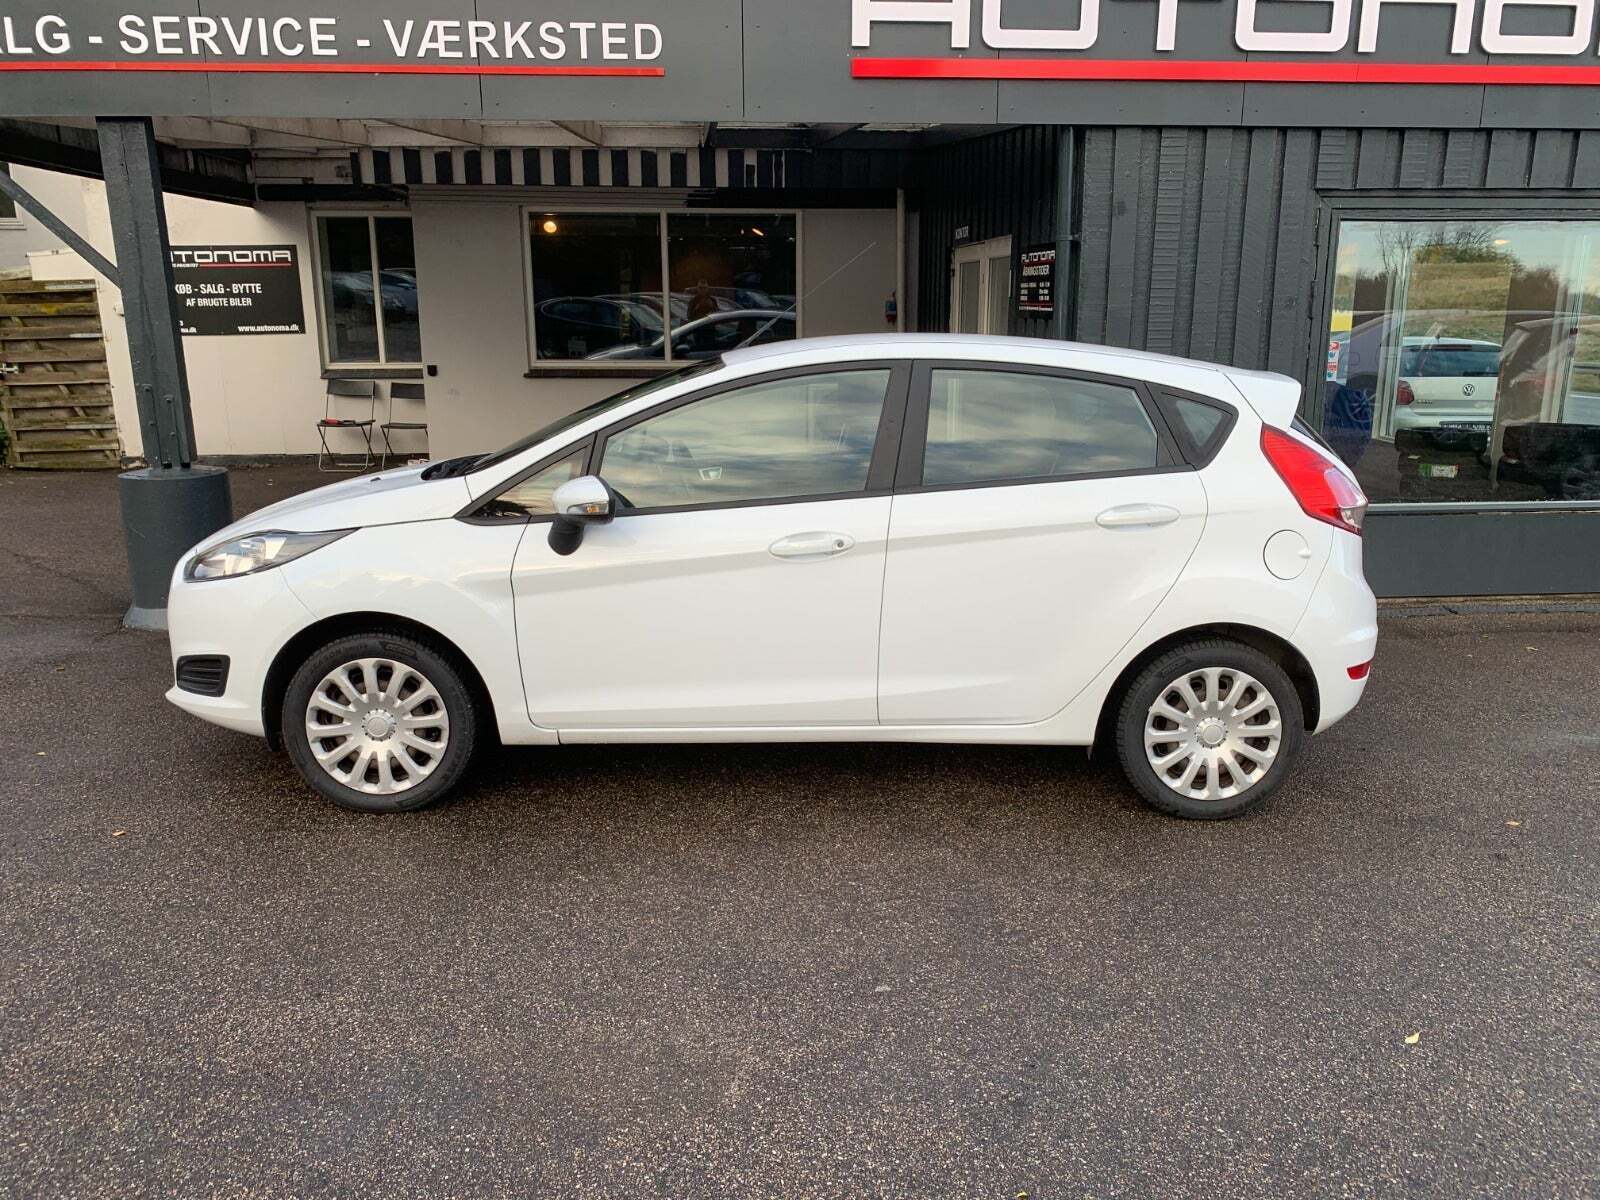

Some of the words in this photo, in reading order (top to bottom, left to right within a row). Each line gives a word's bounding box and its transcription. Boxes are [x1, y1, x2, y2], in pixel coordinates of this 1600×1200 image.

[0, 15, 71, 54] LG
[118, 14, 338, 57] SERVICE
[383, 19, 664, 60] VÆRKSTED
[170, 250, 292, 262] TONOMA
[199, 283, 225, 294] SALG
[232, 283, 263, 294] BYTTE
[186, 298, 197, 307] AF
[197, 297, 229, 307] BRUGTE
[229, 297, 253, 307] BILER
